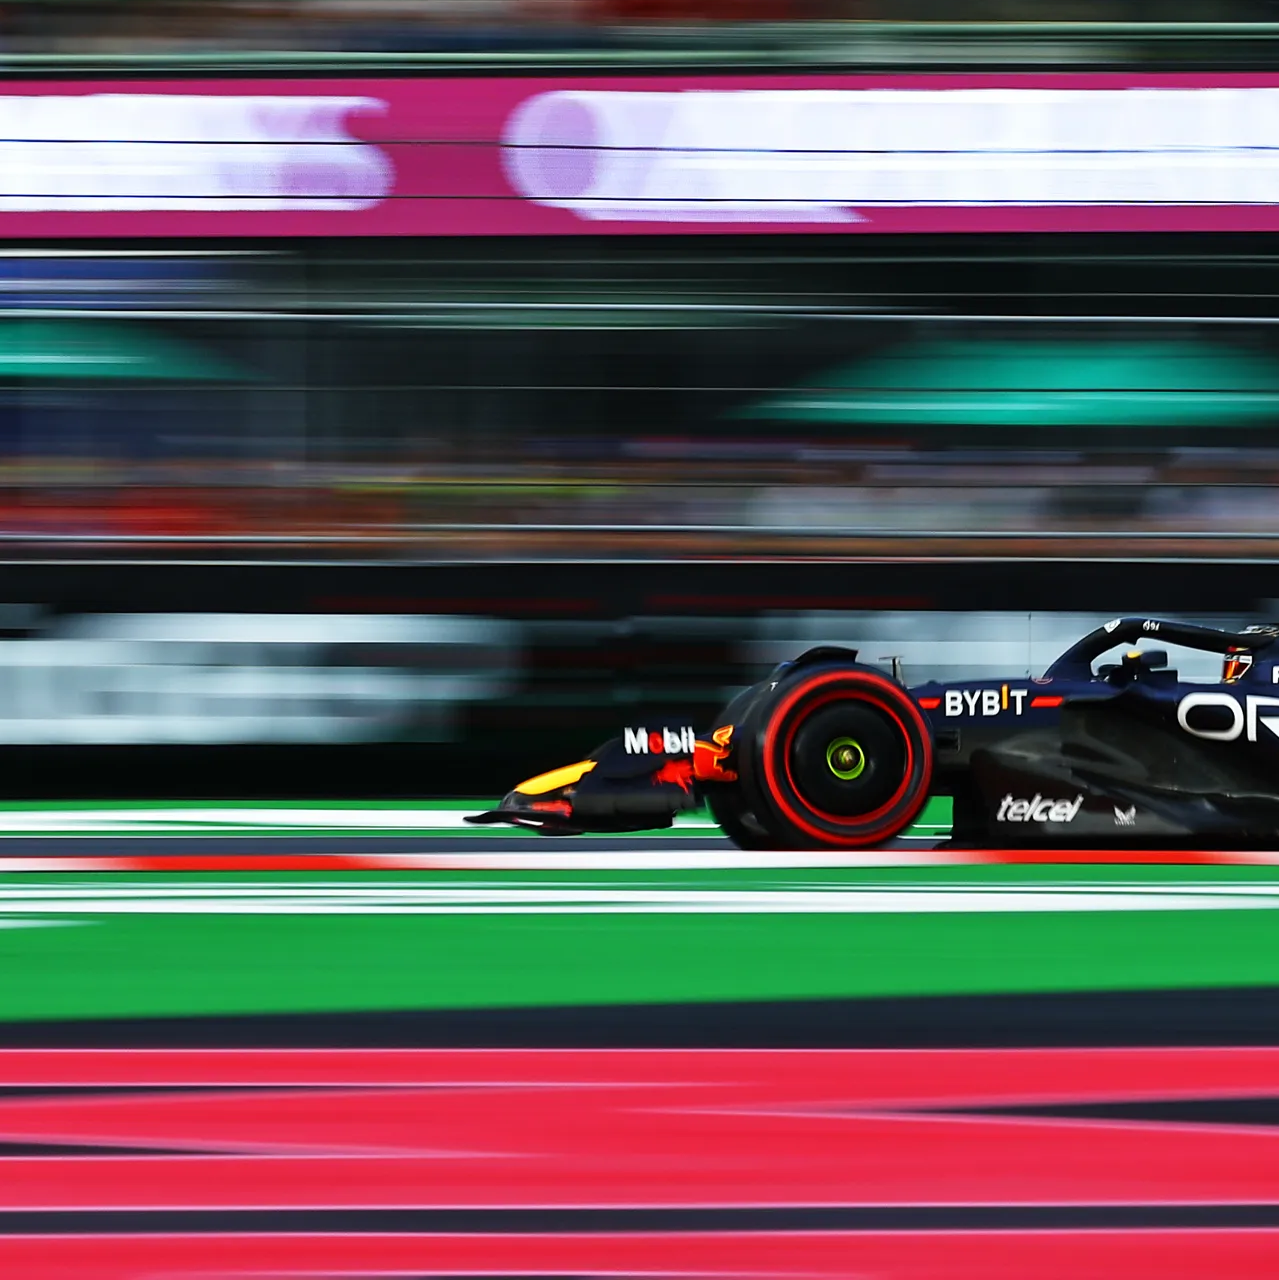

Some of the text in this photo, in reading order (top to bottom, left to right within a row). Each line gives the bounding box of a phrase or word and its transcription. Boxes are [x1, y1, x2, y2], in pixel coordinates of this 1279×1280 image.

[945, 684, 1028, 716] BYBIT
[624, 726, 696, 754] Mobil
[996, 792, 1084, 822] telcel
